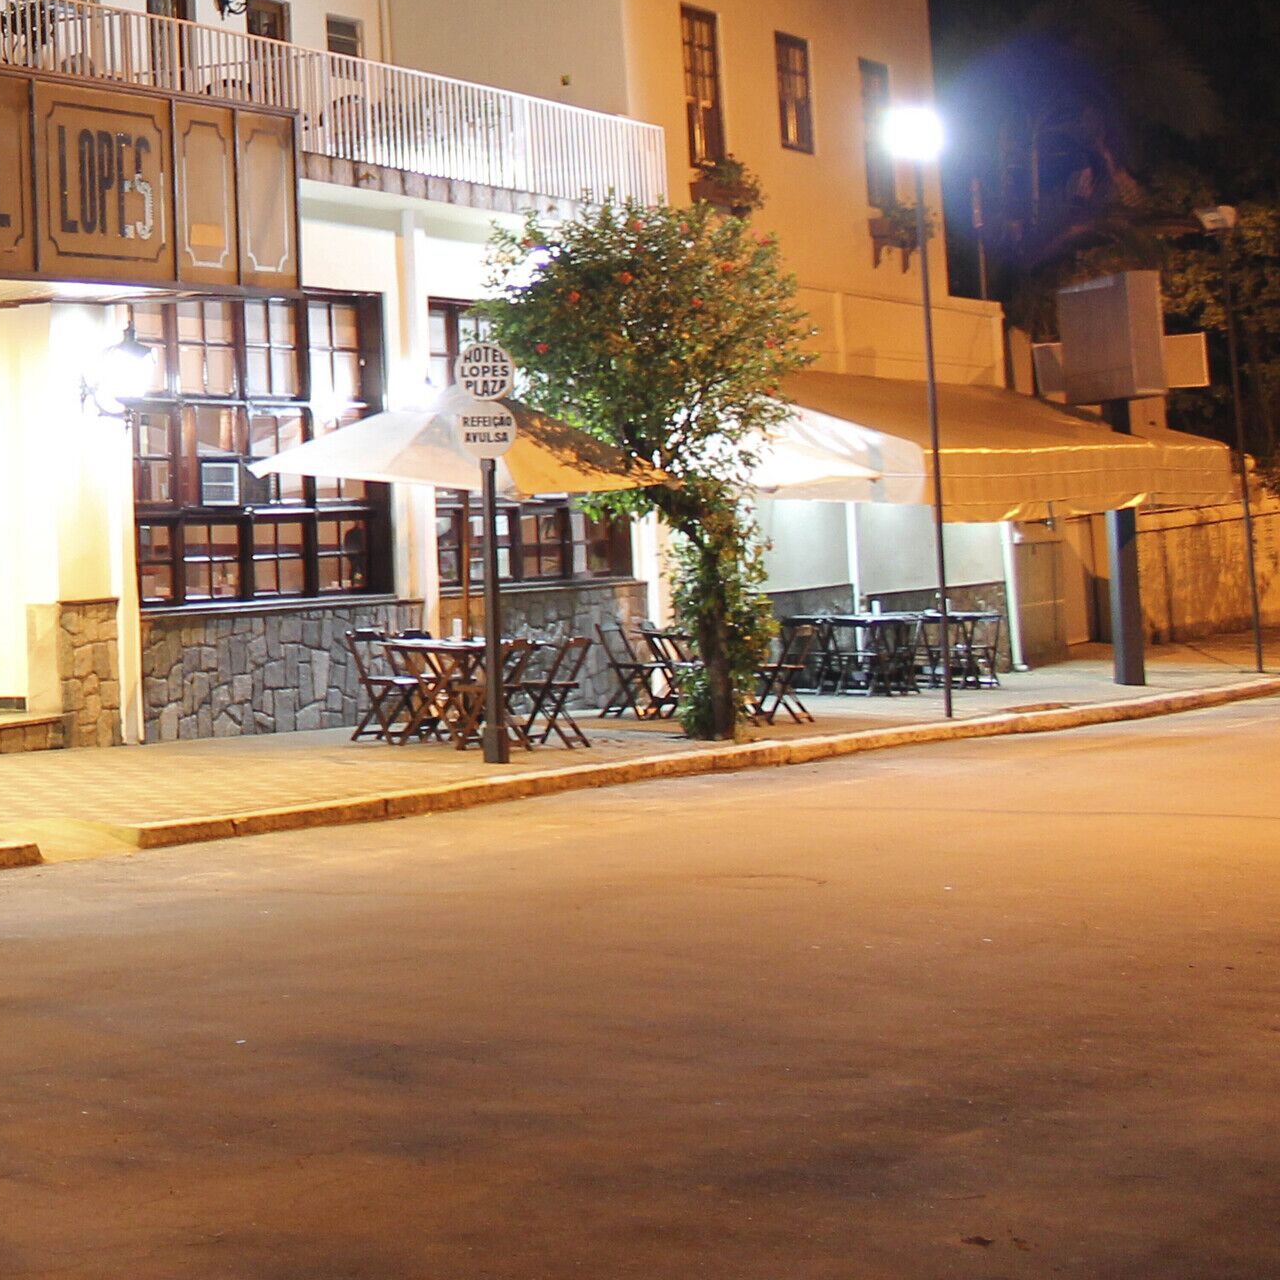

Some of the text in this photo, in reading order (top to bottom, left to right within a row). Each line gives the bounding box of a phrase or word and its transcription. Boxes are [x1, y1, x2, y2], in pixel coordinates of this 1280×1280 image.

[57, 124, 155, 242] LOPES
[463, 346, 509, 364] HOTEL
[460, 365, 510, 378] LOPES
[465, 379, 507, 397] PLAZA
[462, 412, 513, 428] REFEIÇÃO
[464, 431, 510, 443] AVULSA
